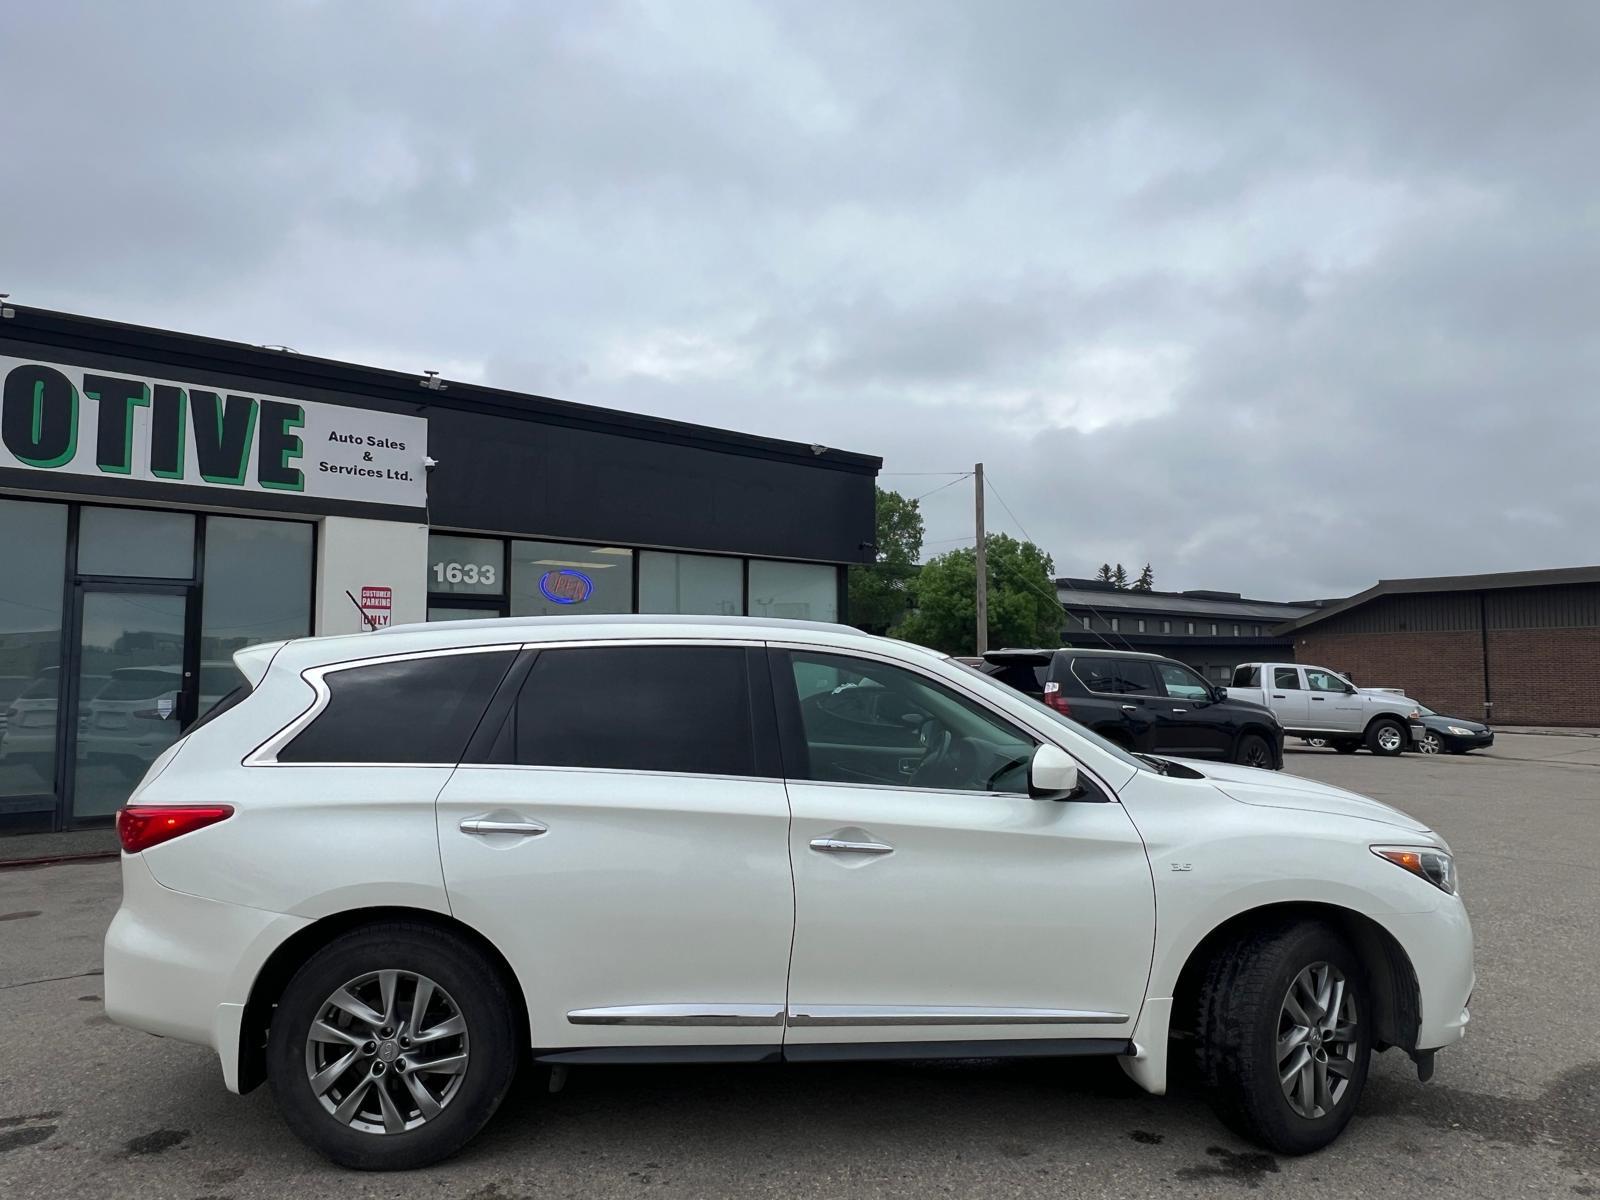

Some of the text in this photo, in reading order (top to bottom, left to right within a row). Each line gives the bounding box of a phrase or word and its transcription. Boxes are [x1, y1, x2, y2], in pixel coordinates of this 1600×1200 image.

[2, 364, 306, 493] OTIVE
[328, 430, 406, 451] Auto Sales
[362, 451, 373, 462] &
[319, 461, 413, 482] Services Ltd.
[433, 562, 496, 585] 1633
[362, 590, 391, 598] CUSTOMER
[546, 571, 587, 600] OPEN
[362, 597, 391, 607] PARKING
[363, 614, 388, 626] ONLY
